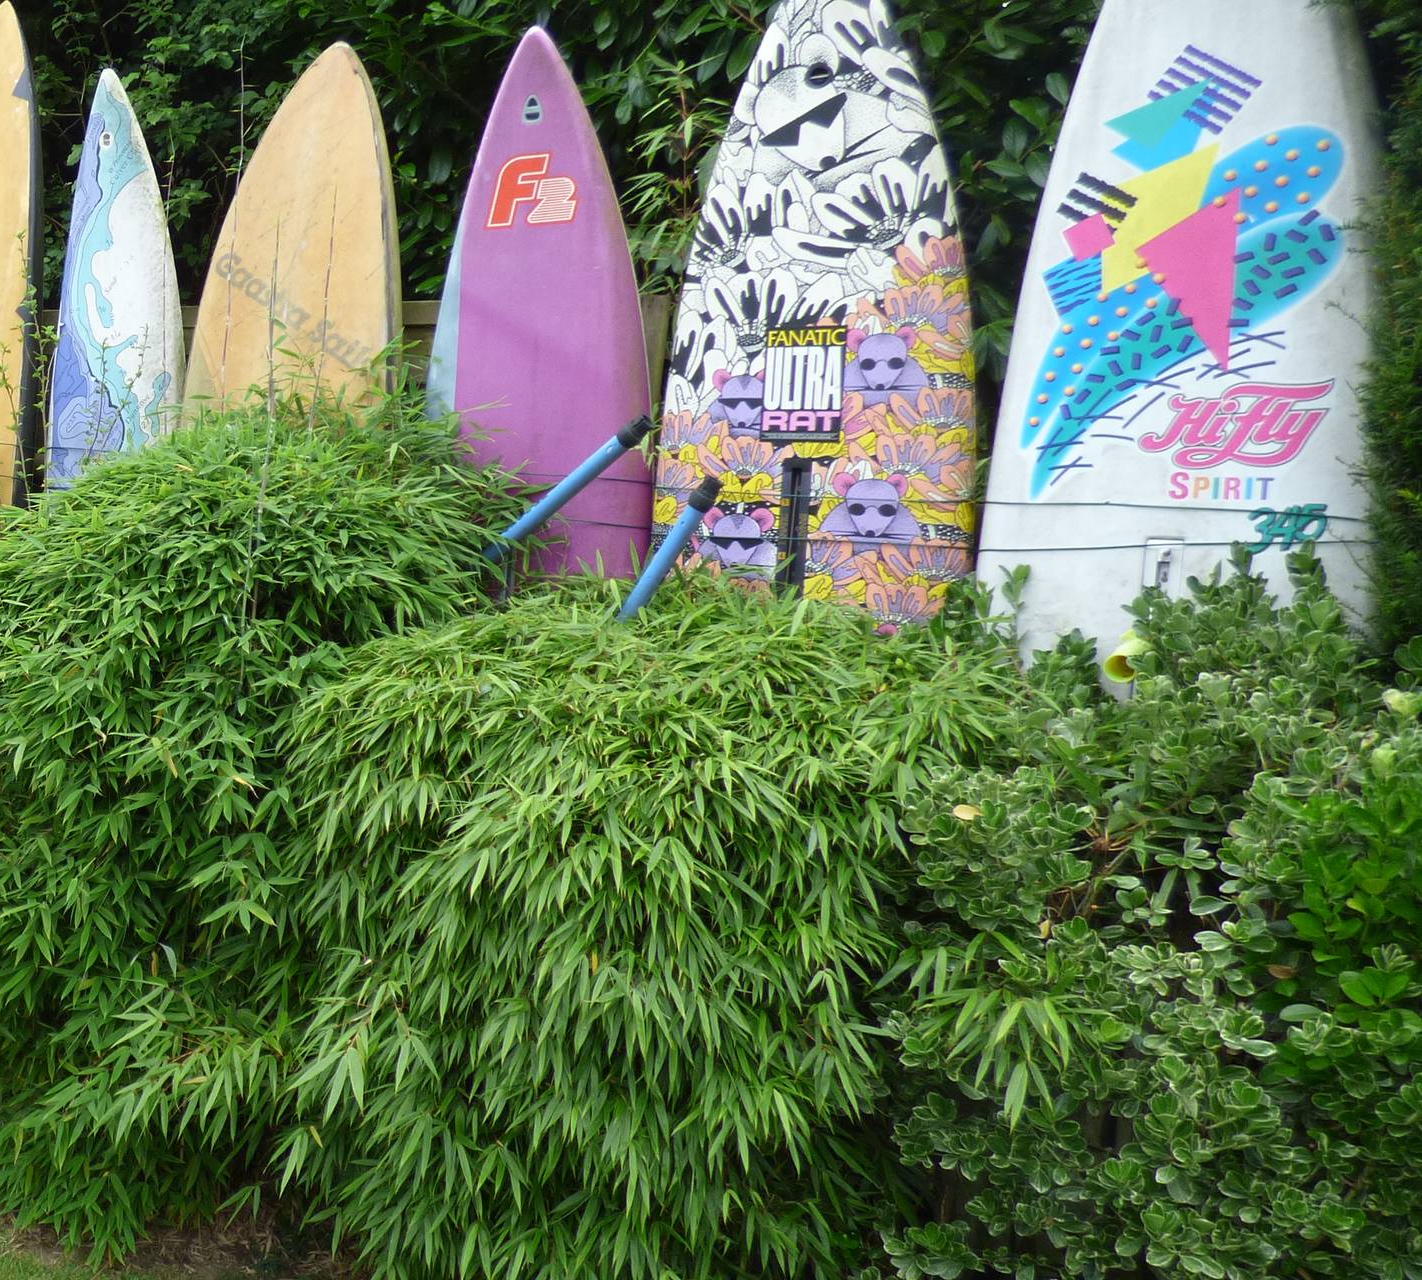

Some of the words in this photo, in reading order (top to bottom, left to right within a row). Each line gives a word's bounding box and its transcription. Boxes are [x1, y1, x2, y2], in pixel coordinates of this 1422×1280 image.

[486, 152, 576, 227] F2
[216, 252, 310, 332] Gaasta
[307, 318, 371, 370] Sail
[768, 328, 846, 347] FANATIC
[763, 346, 843, 411] ULTRA
[762, 410, 841, 432] RAT
[1168, 471, 1275, 500] SPIRIT
[1248, 503, 1328, 555] 345
